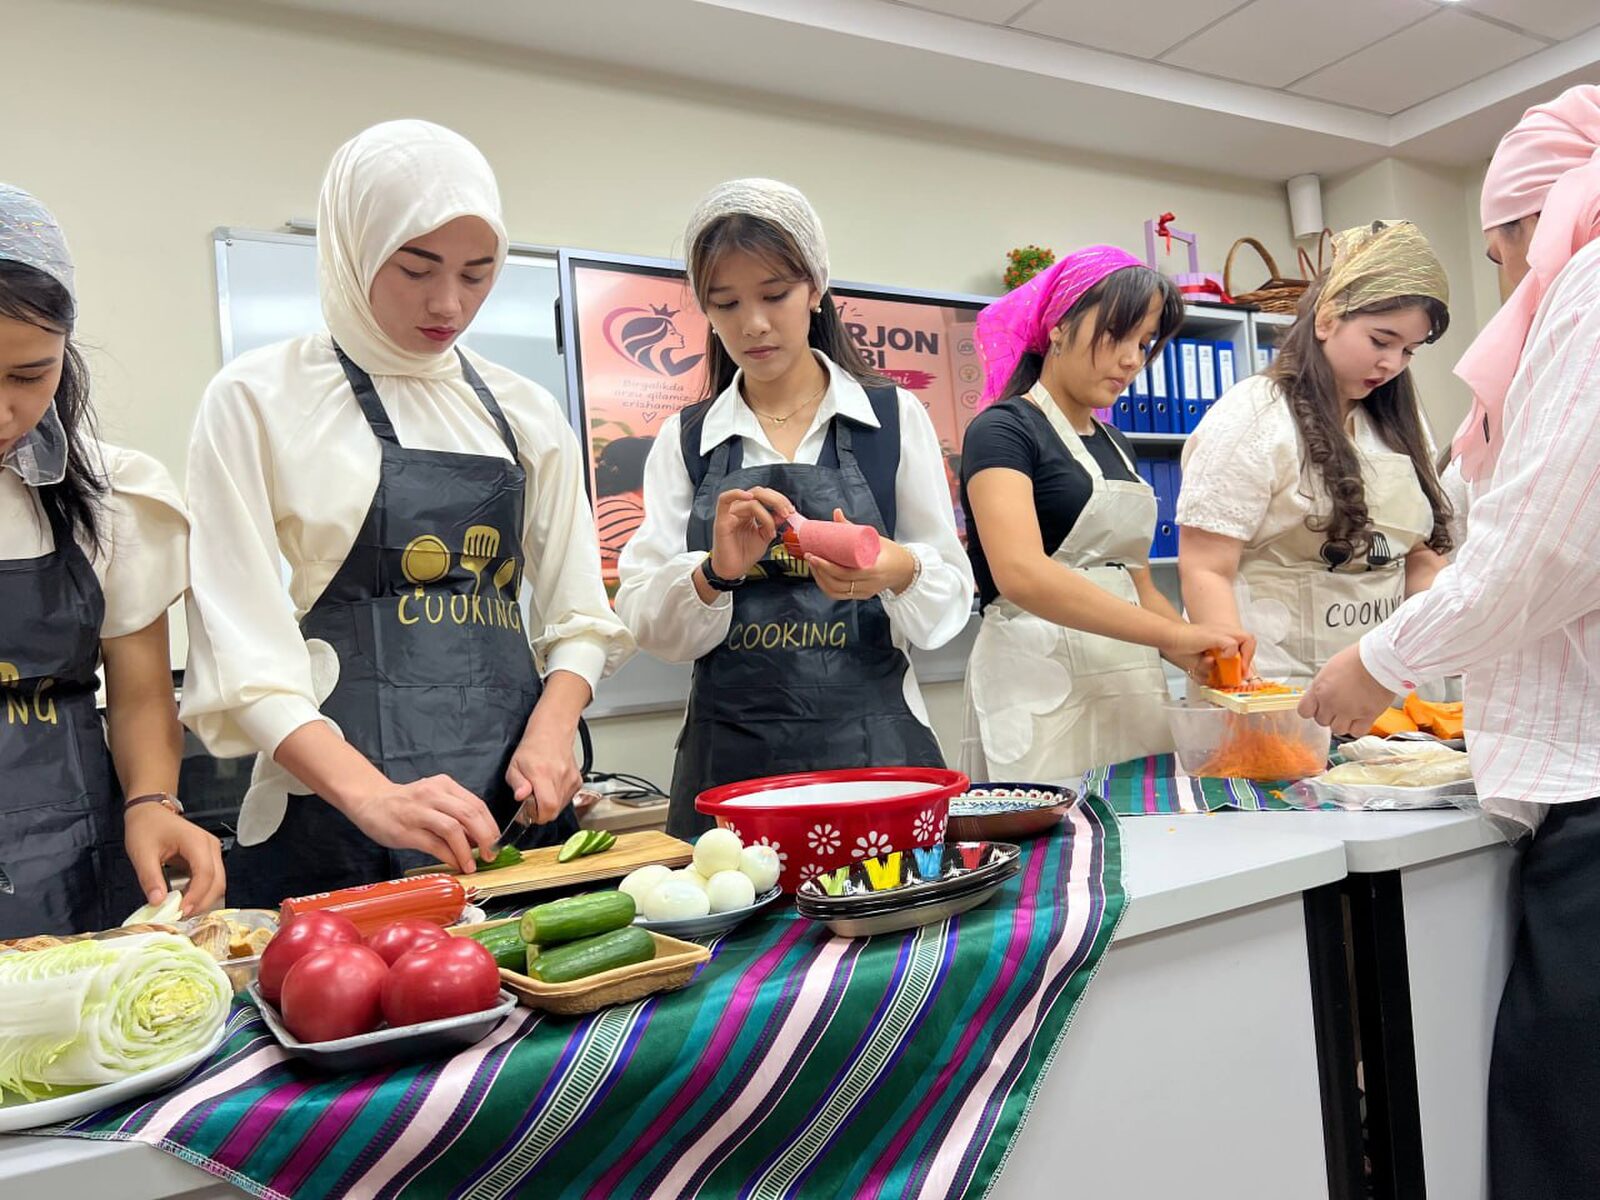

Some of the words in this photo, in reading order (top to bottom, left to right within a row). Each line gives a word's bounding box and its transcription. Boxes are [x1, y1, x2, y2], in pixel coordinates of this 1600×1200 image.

[844, 322, 939, 355] RJON
[858, 348, 886, 369] BI
[398, 594, 520, 633] COOKING
[1325, 595, 1402, 628] COOKIN
[728, 622, 846, 650] COOKING
[7, 678, 58, 725] NG
